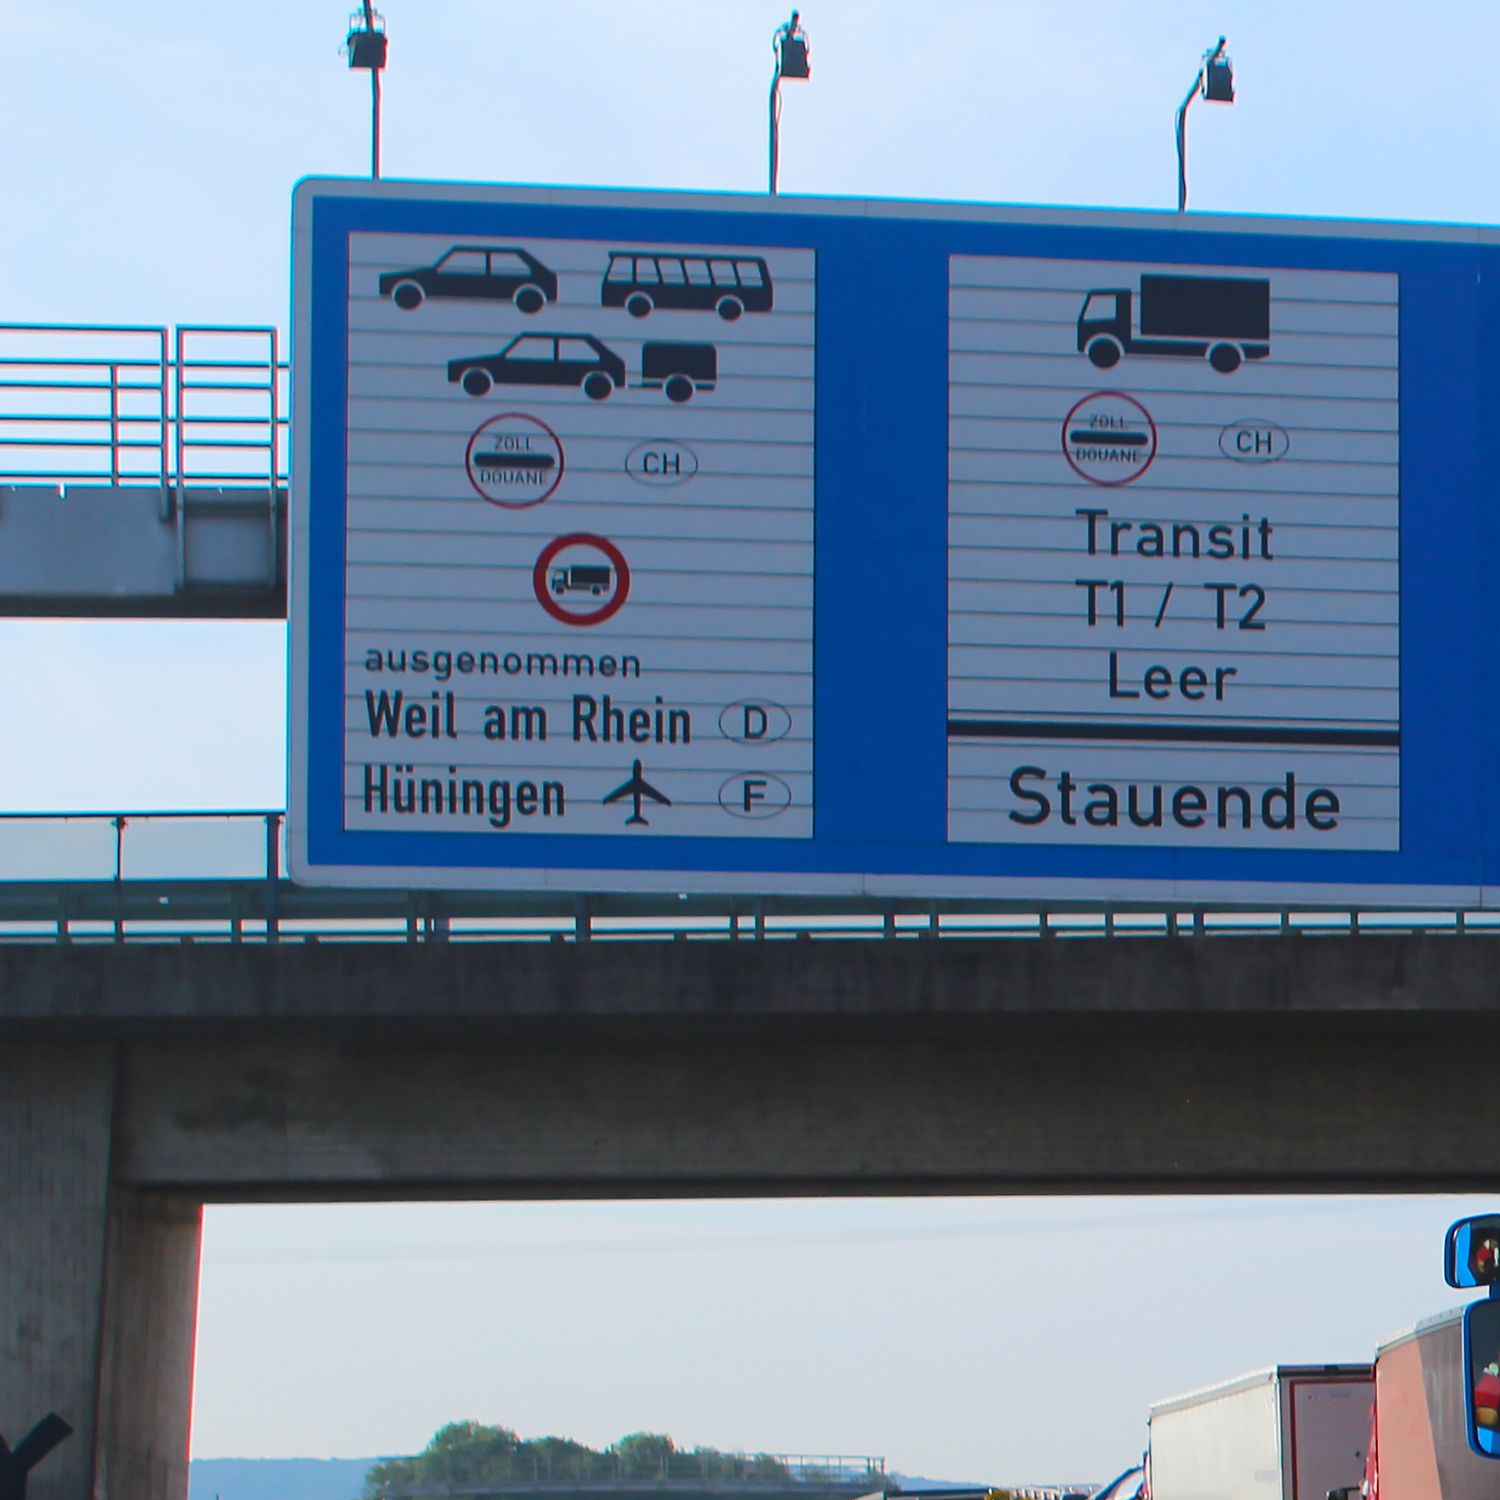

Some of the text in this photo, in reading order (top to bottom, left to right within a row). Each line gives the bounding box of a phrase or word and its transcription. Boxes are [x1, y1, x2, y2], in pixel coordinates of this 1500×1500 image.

[1075, 448, 1142, 464] DOUANE
[1236, 431, 1272, 454] CH
[480, 470, 548, 485] DOUANE
[643, 452, 681, 475] CH
[1075, 508, 1274, 561] Transit
[1075, 579, 1126, 628] T1
[1204, 582, 1267, 631] T2
[364, 648, 641, 681] ausgenommen
[1107, 651, 1237, 701] Leer
[364, 690, 692, 744] Weil am Rhein
[743, 706, 768, 740] D
[363, 764, 566, 829] Hüningen
[743, 780, 768, 812] F
[1008, 765, 1341, 832] Stauende
